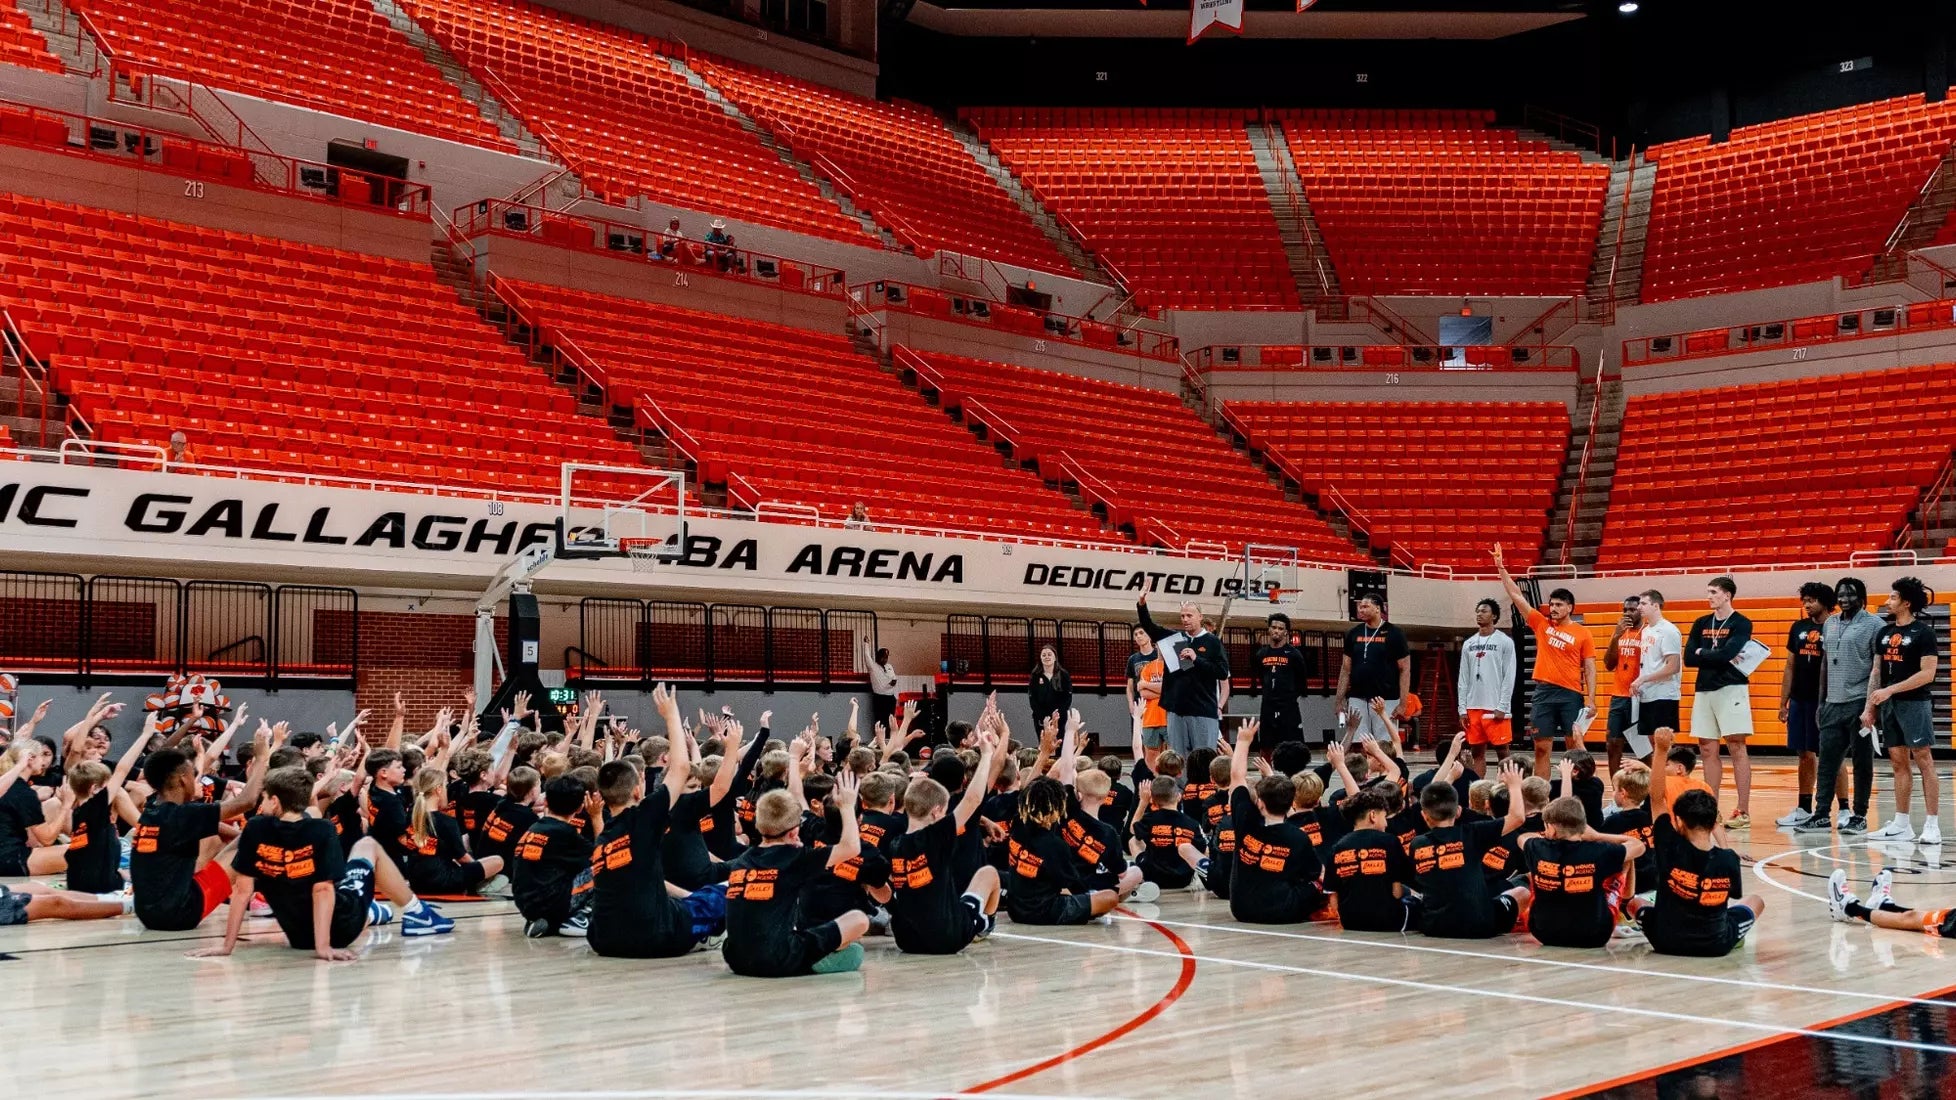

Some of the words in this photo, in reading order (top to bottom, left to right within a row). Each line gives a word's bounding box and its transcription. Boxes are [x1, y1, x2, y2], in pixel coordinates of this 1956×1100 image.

[1839, 60, 1854, 72] 323
[1096, 72, 1108, 80] 321
[1356, 73, 1368, 82] 322
[184, 180, 204, 198] 213
[675, 271, 689, 287] 214
[1792, 347, 1807, 359] 217
[1385, 373, 1399, 383] 216
[488, 501, 503, 516] 108
[785, 543, 964, 584] ARENA
[1023, 563, 1205, 595] DEDICATED
[1548, 636, 1567, 651] STATE
[527, 646, 534, 656] 5
[550, 690, 575, 700] 10:31
